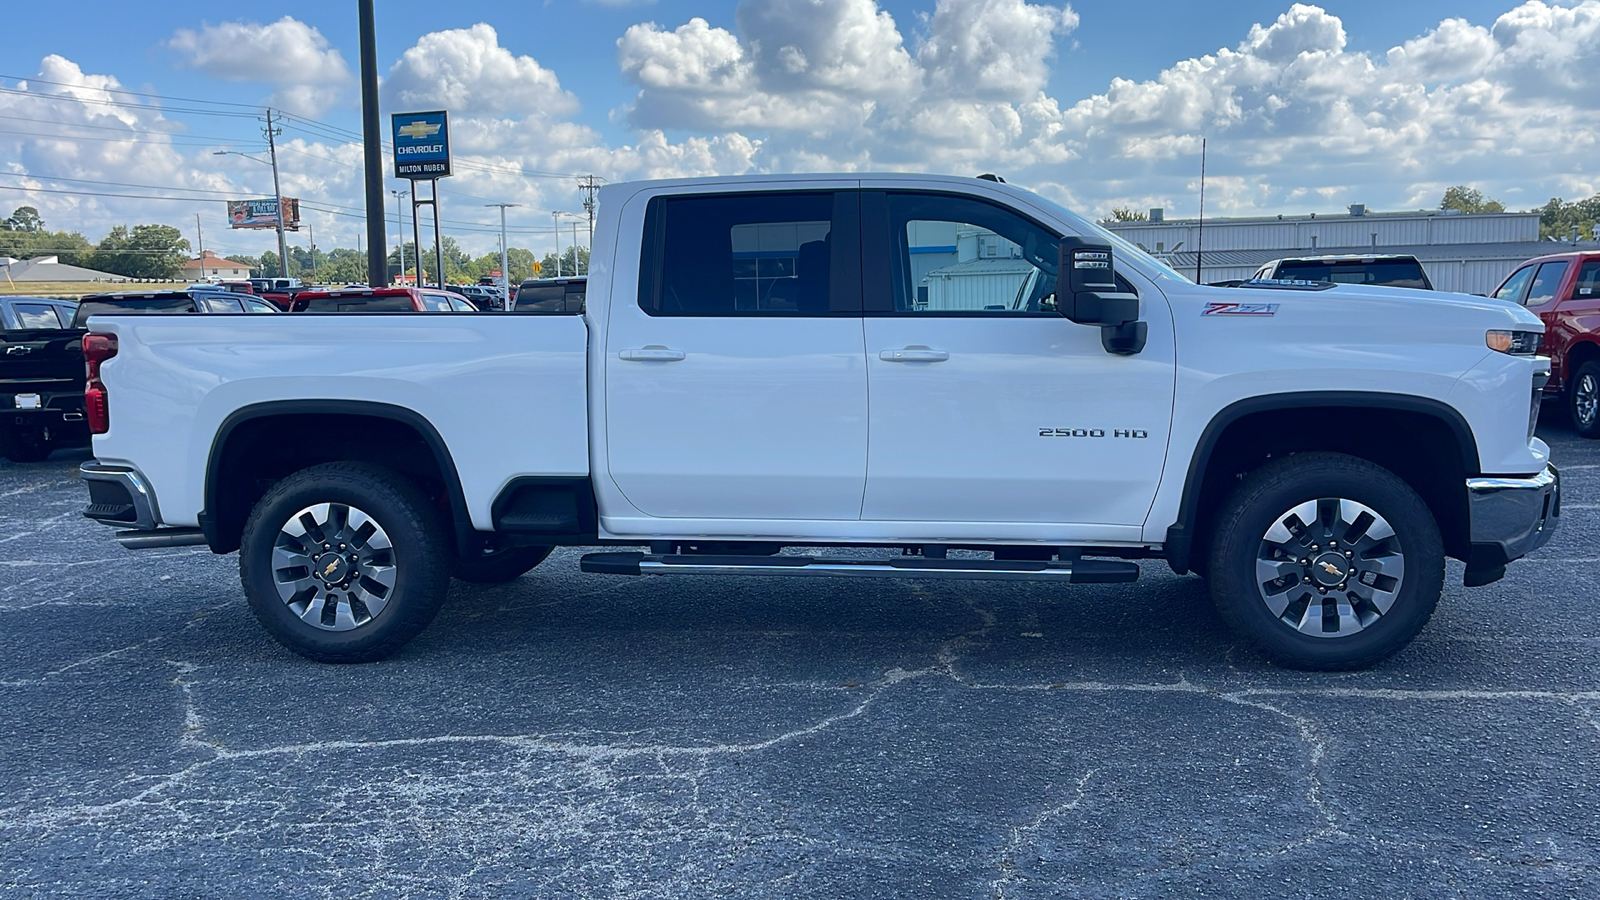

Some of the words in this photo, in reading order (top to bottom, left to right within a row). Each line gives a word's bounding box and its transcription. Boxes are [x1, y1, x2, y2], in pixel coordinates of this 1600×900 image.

[398, 145, 443, 154] CHEVROLET
[399, 165, 422, 173] MILTON
[424, 163, 445, 172] RUBEN
[1200, 302, 1281, 317] Z71
[1039, 427, 1105, 438] 2500
[1113, 428, 1148, 439] HD
